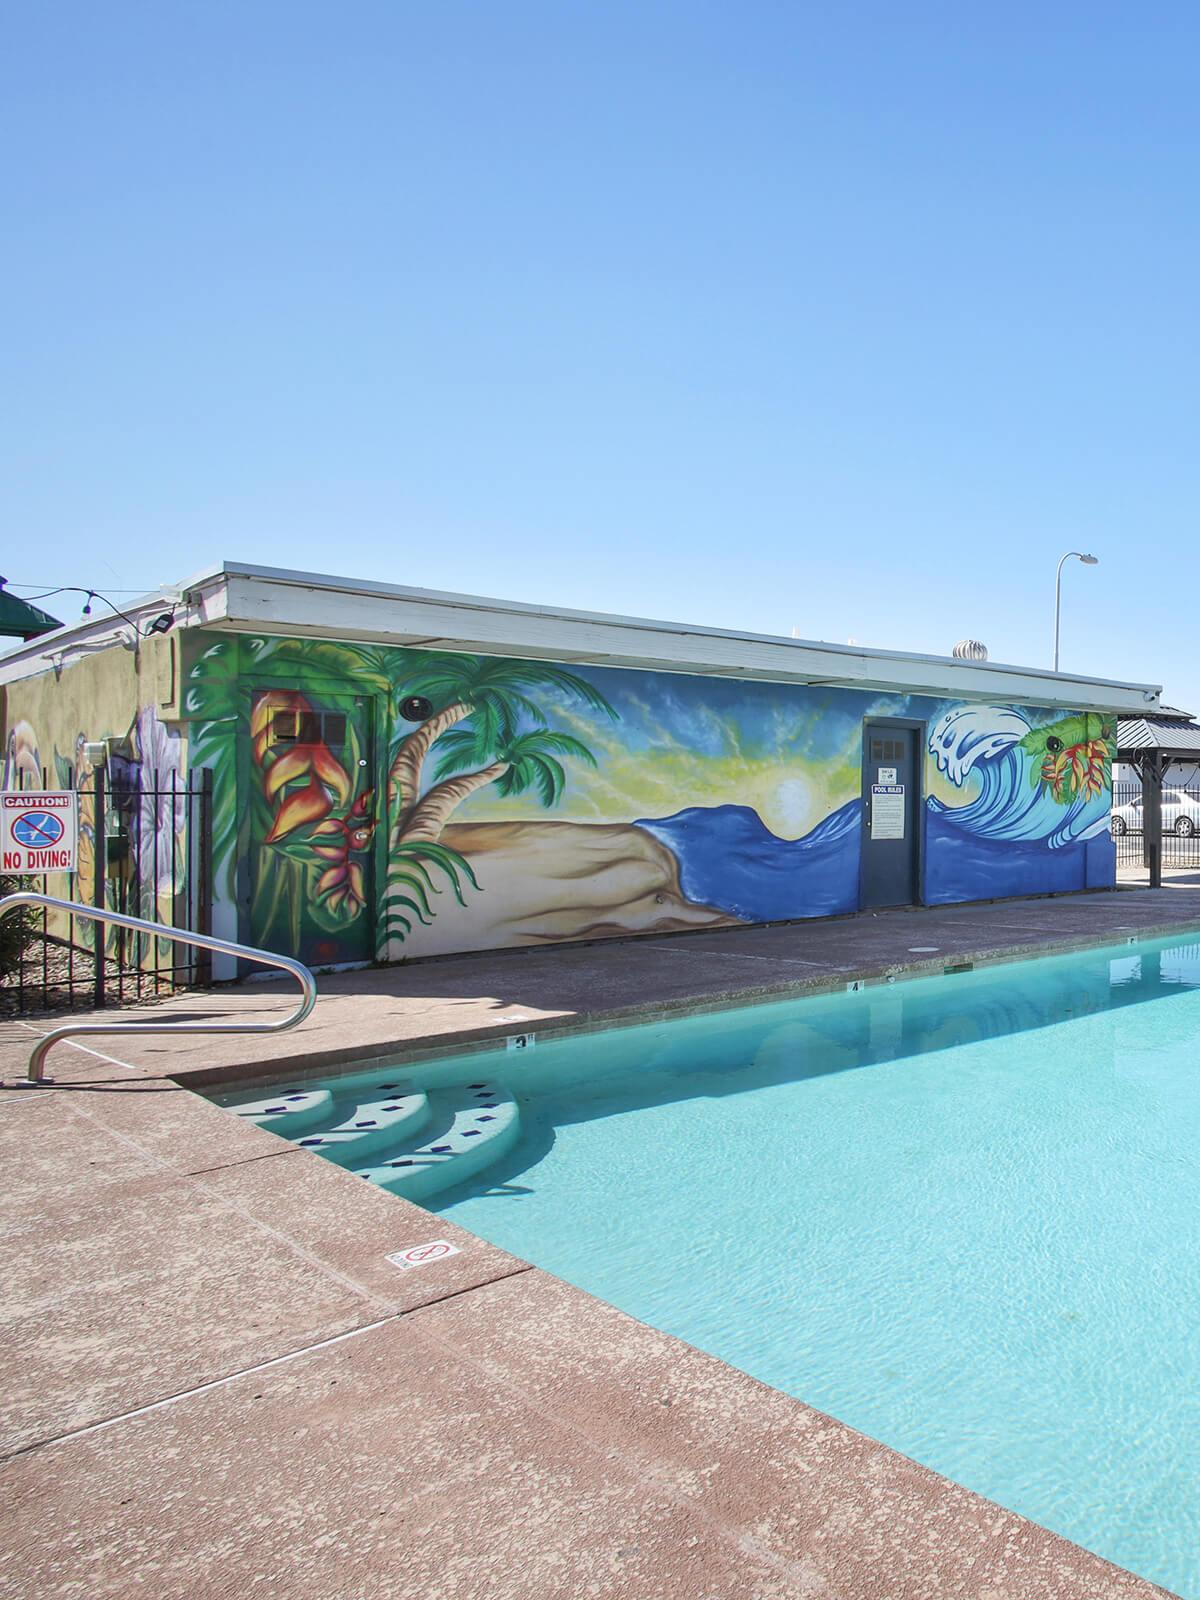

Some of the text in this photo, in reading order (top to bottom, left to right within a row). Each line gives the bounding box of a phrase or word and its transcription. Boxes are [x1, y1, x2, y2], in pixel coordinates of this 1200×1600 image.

[5, 798, 68, 806] CAUTION!
[4, 850, 71, 869] NO DIVING!
